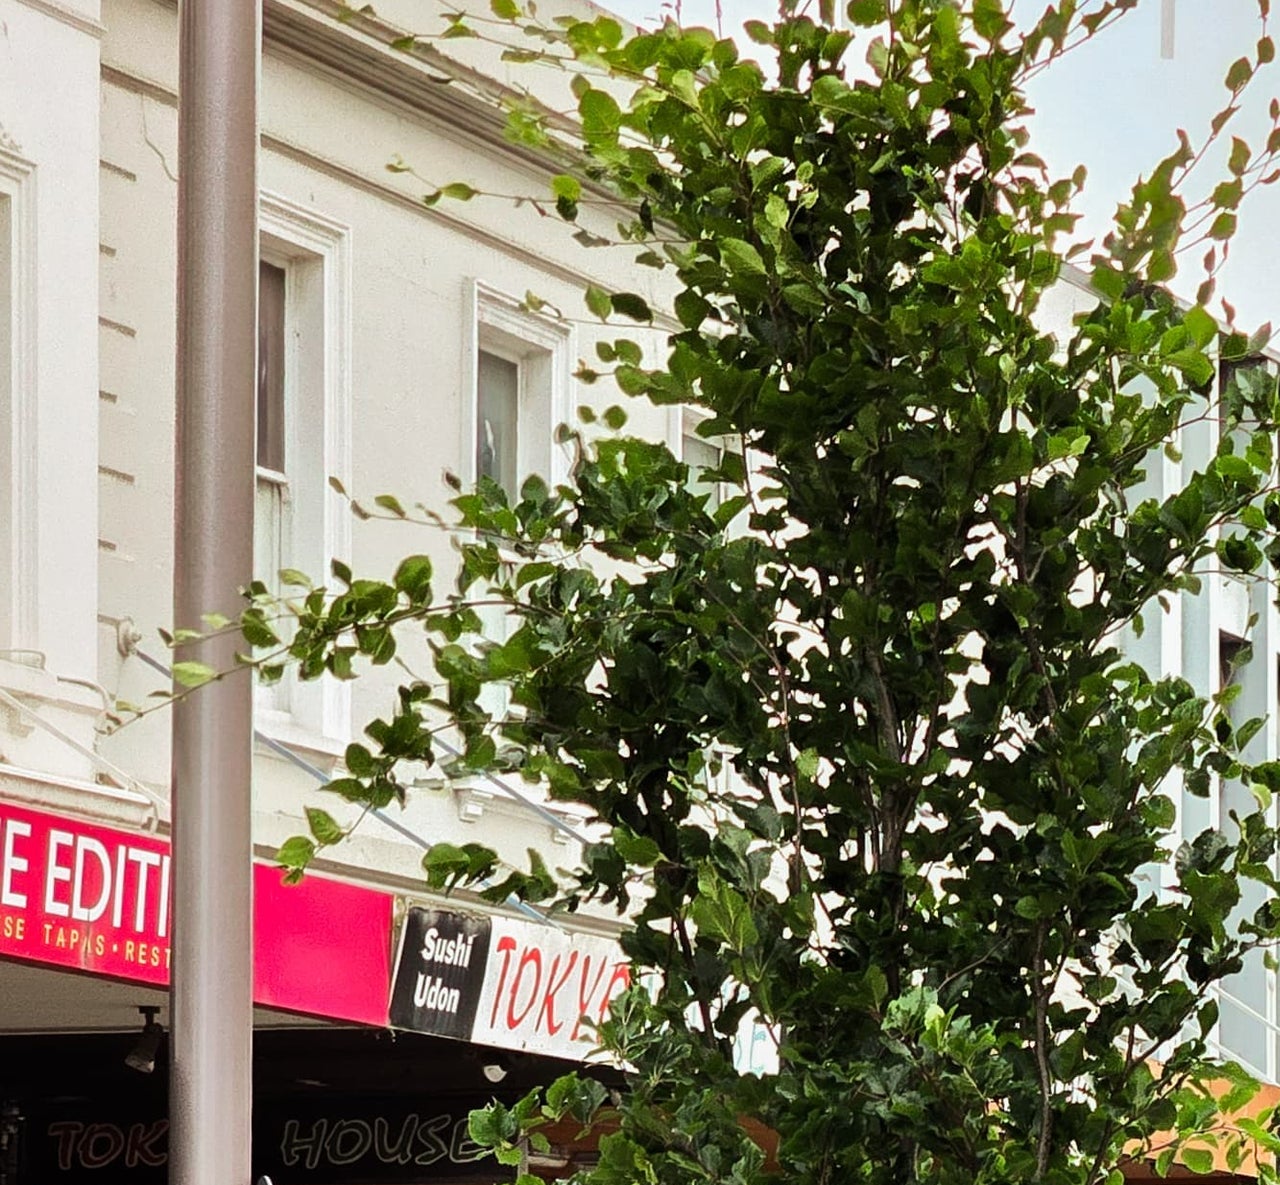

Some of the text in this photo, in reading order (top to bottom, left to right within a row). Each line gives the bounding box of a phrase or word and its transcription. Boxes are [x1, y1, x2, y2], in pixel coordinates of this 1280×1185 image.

[0, 818, 171, 938] E EDITI
[0, 915, 171, 969] SE TAPAS REST
[420, 927, 474, 969] Sushi
[413, 972, 461, 1014] Udon
[47, 1114, 490, 1170] TOK HOUSE
